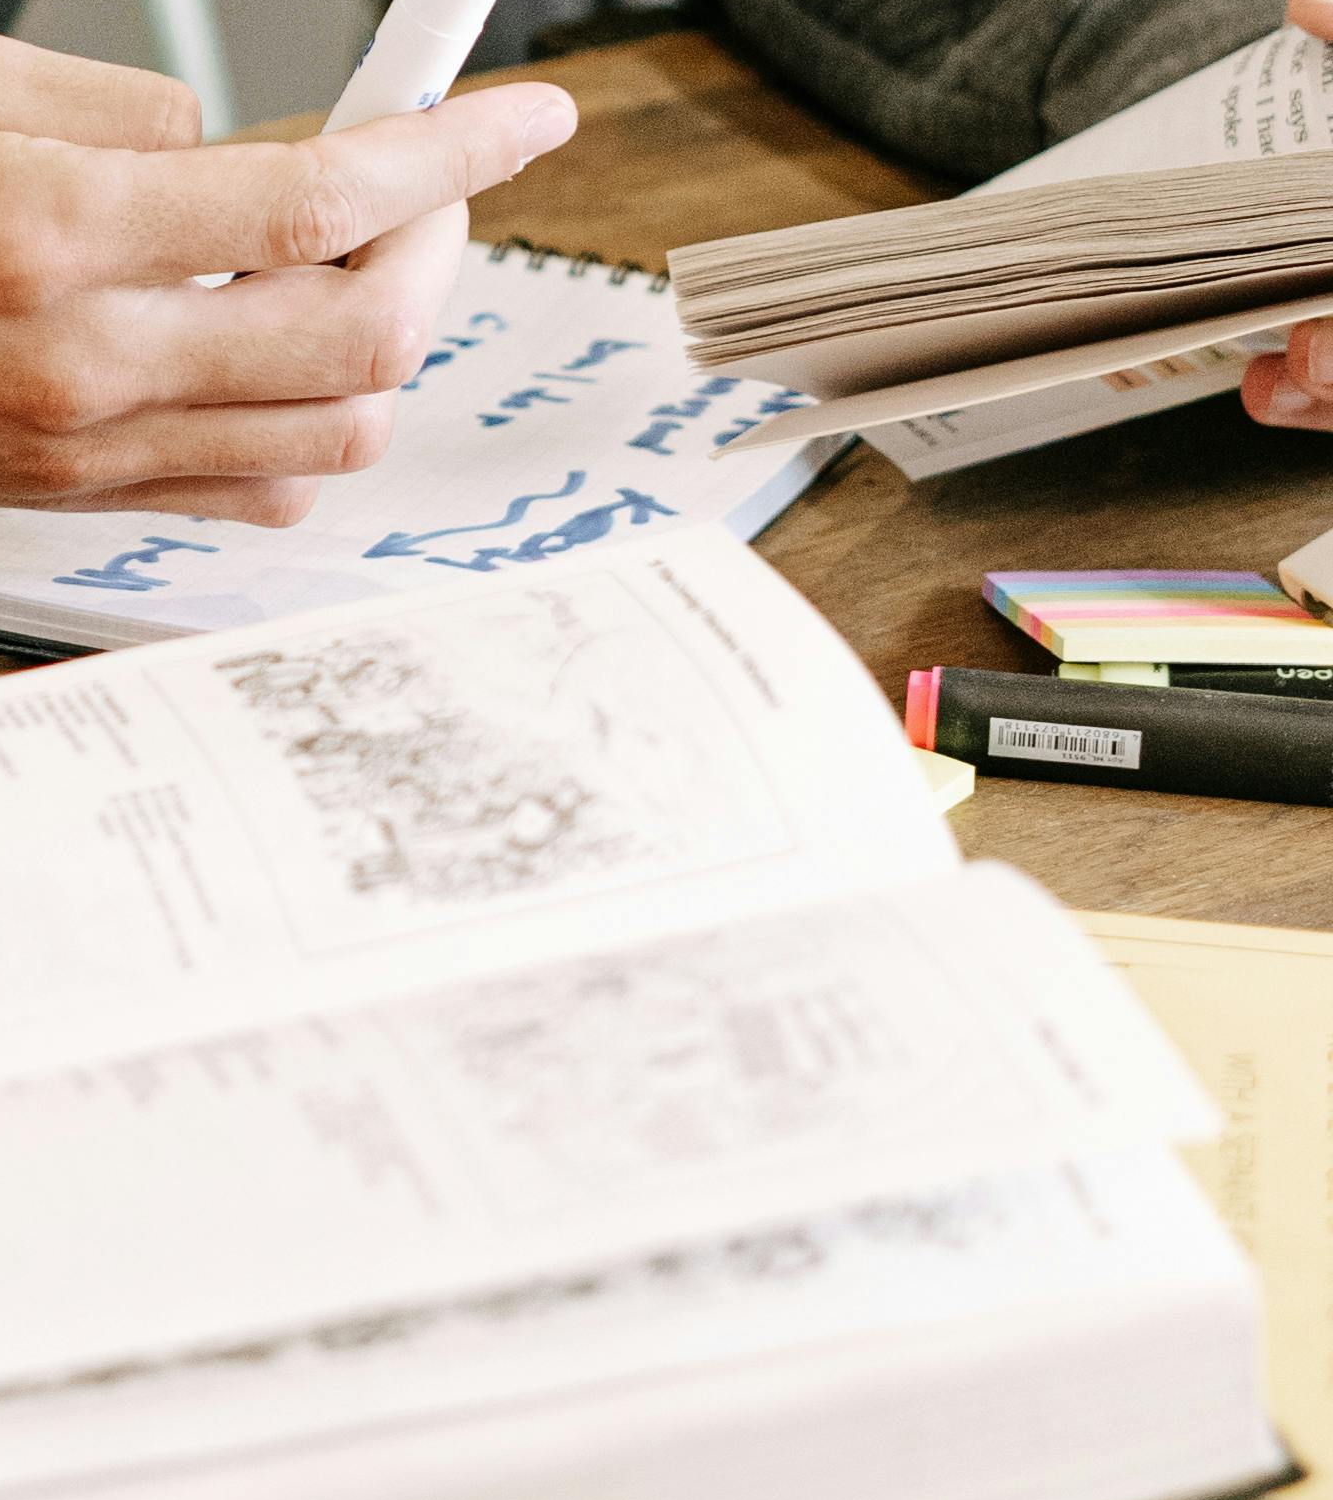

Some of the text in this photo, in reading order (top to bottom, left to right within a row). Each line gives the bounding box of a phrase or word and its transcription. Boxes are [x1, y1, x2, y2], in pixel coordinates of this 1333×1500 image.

[1286, 89, 1308, 142] says
[1005, 721, 1059, 734] 075118
[1067, 728, 1120, 740] 680211
